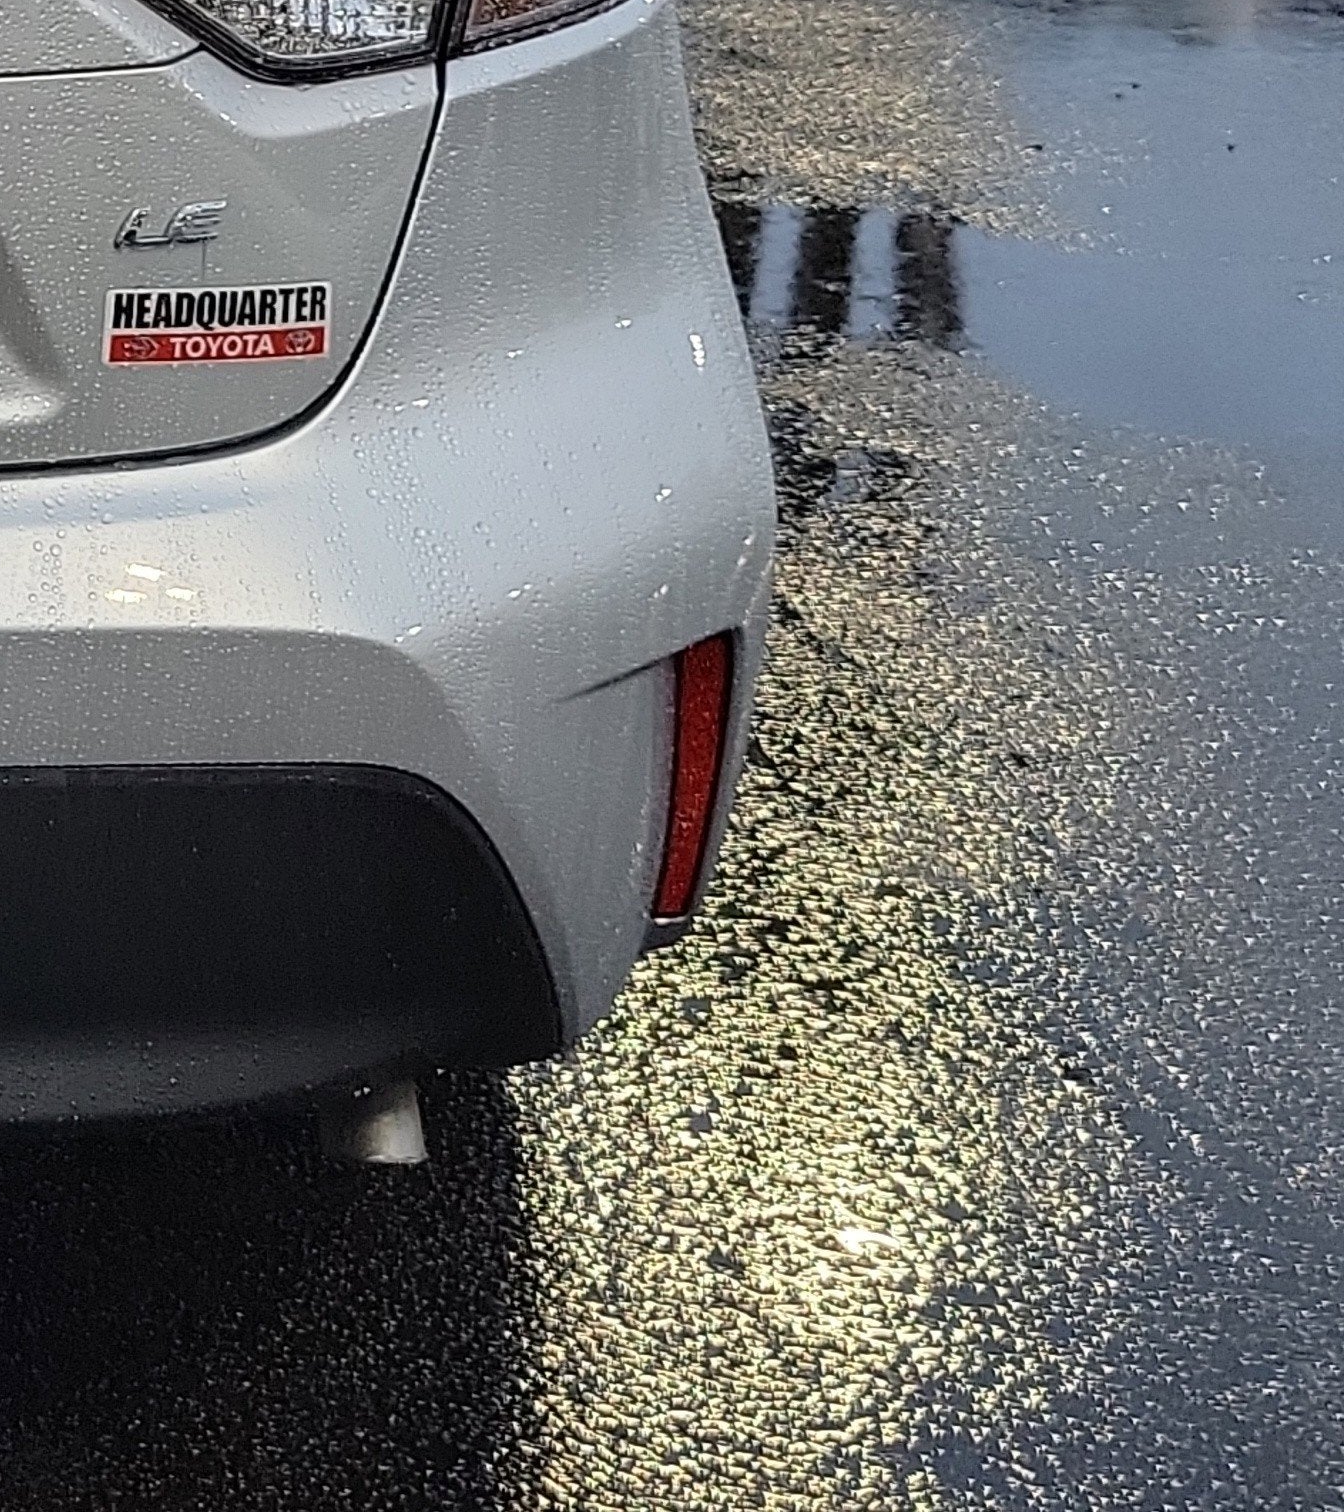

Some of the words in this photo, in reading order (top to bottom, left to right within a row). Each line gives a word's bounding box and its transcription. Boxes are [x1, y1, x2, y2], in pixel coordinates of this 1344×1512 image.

[114, 199, 228, 250] LE
[112, 285, 327, 330] HEADQUARTER
[169, 333, 276, 359] TOYOTA
